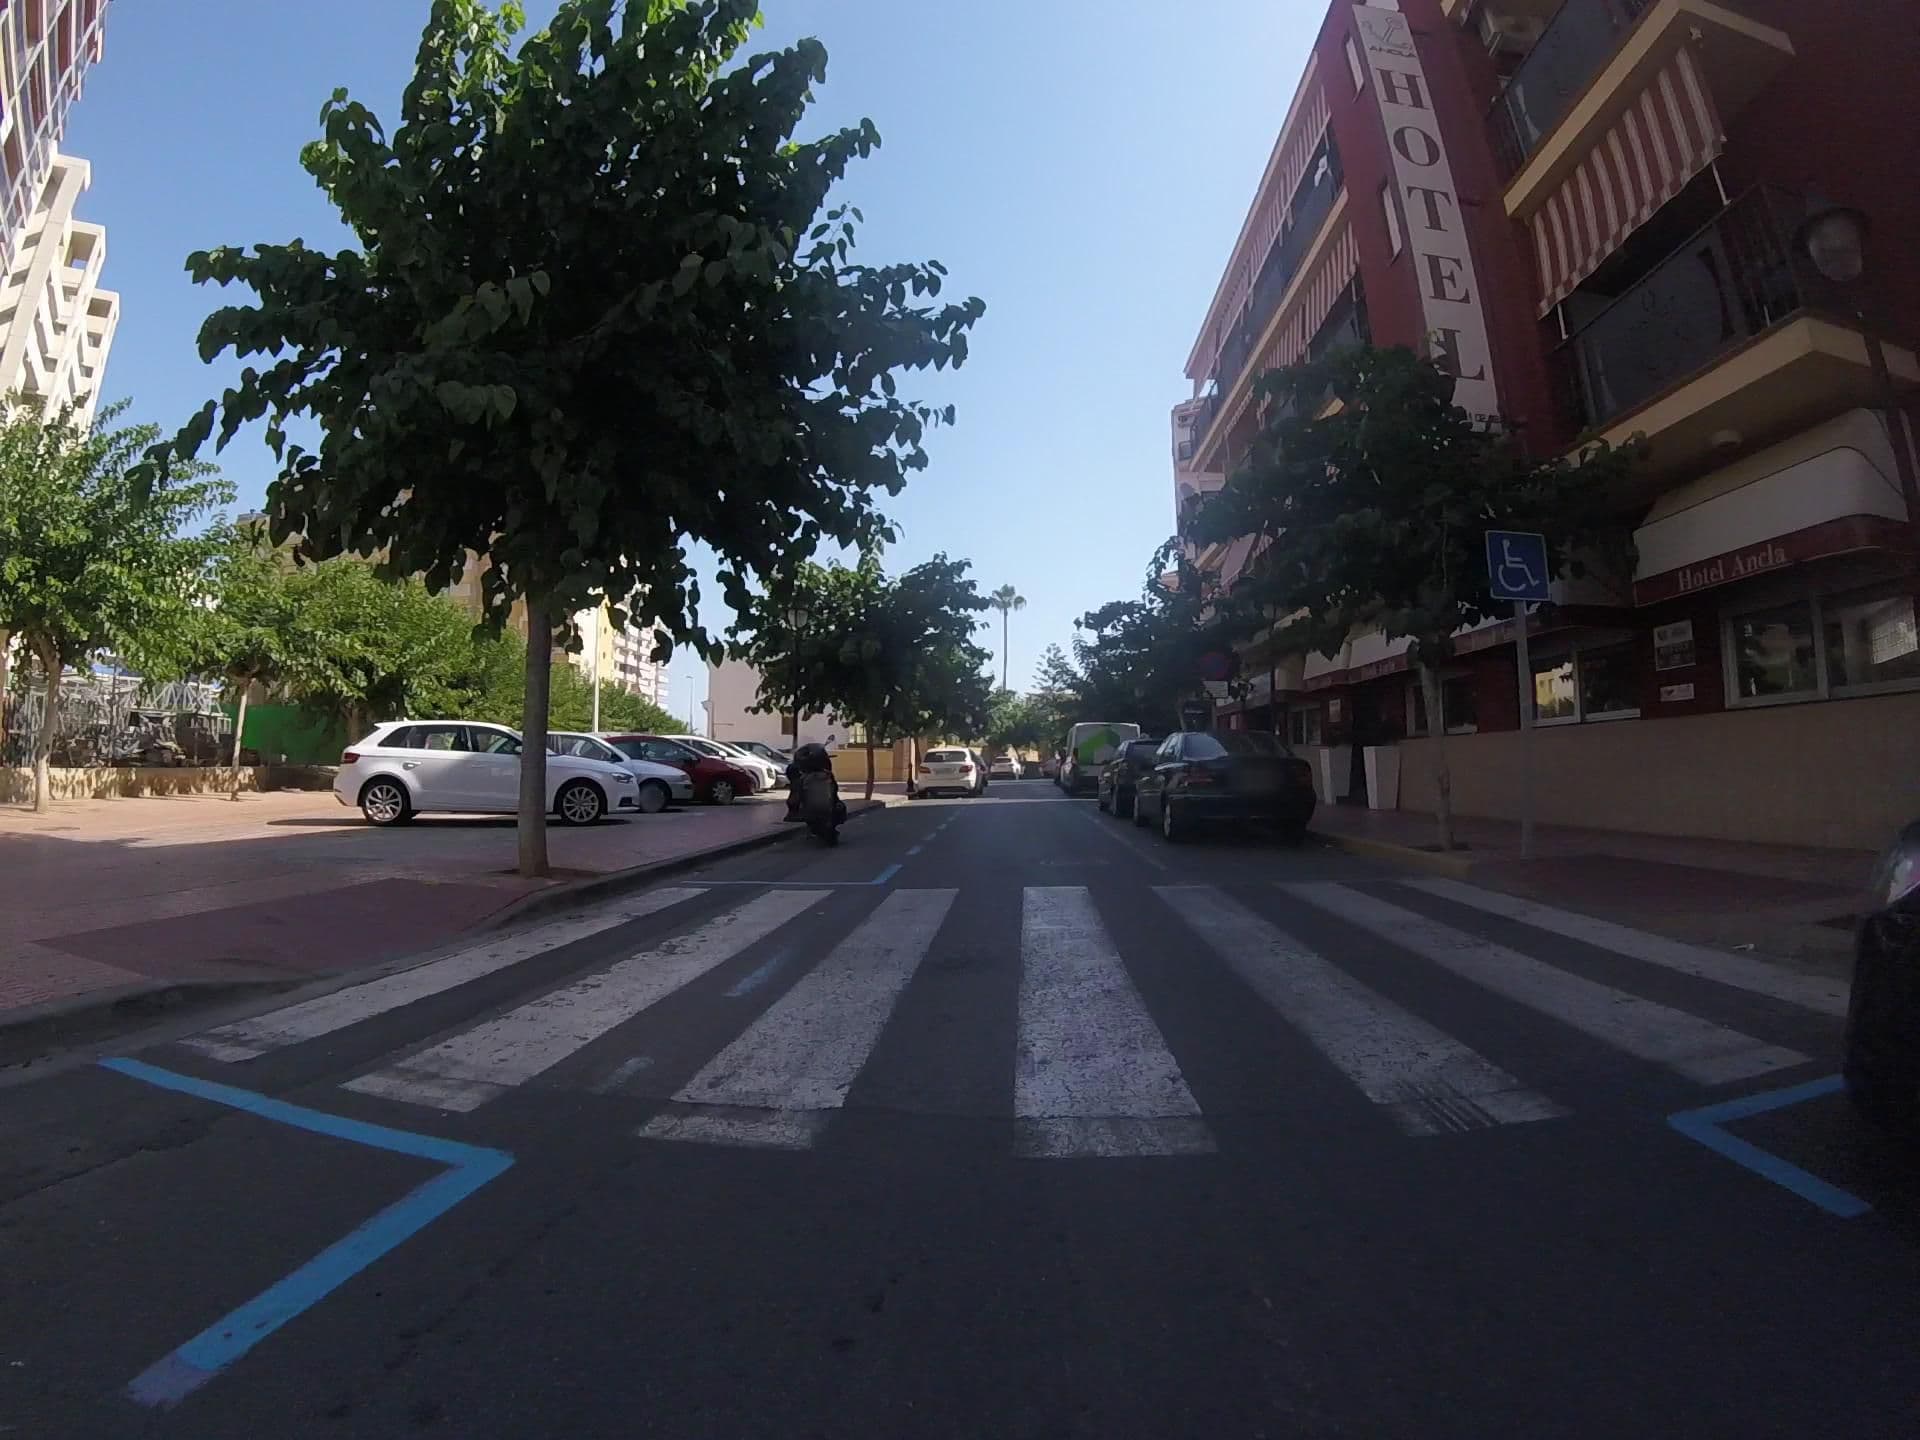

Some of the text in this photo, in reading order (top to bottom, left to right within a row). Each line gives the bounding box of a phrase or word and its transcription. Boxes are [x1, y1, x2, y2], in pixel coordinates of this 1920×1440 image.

[1375, 68, 1485, 381] HOTEL
[1677, 543, 1786, 592] Hotel Ancla
